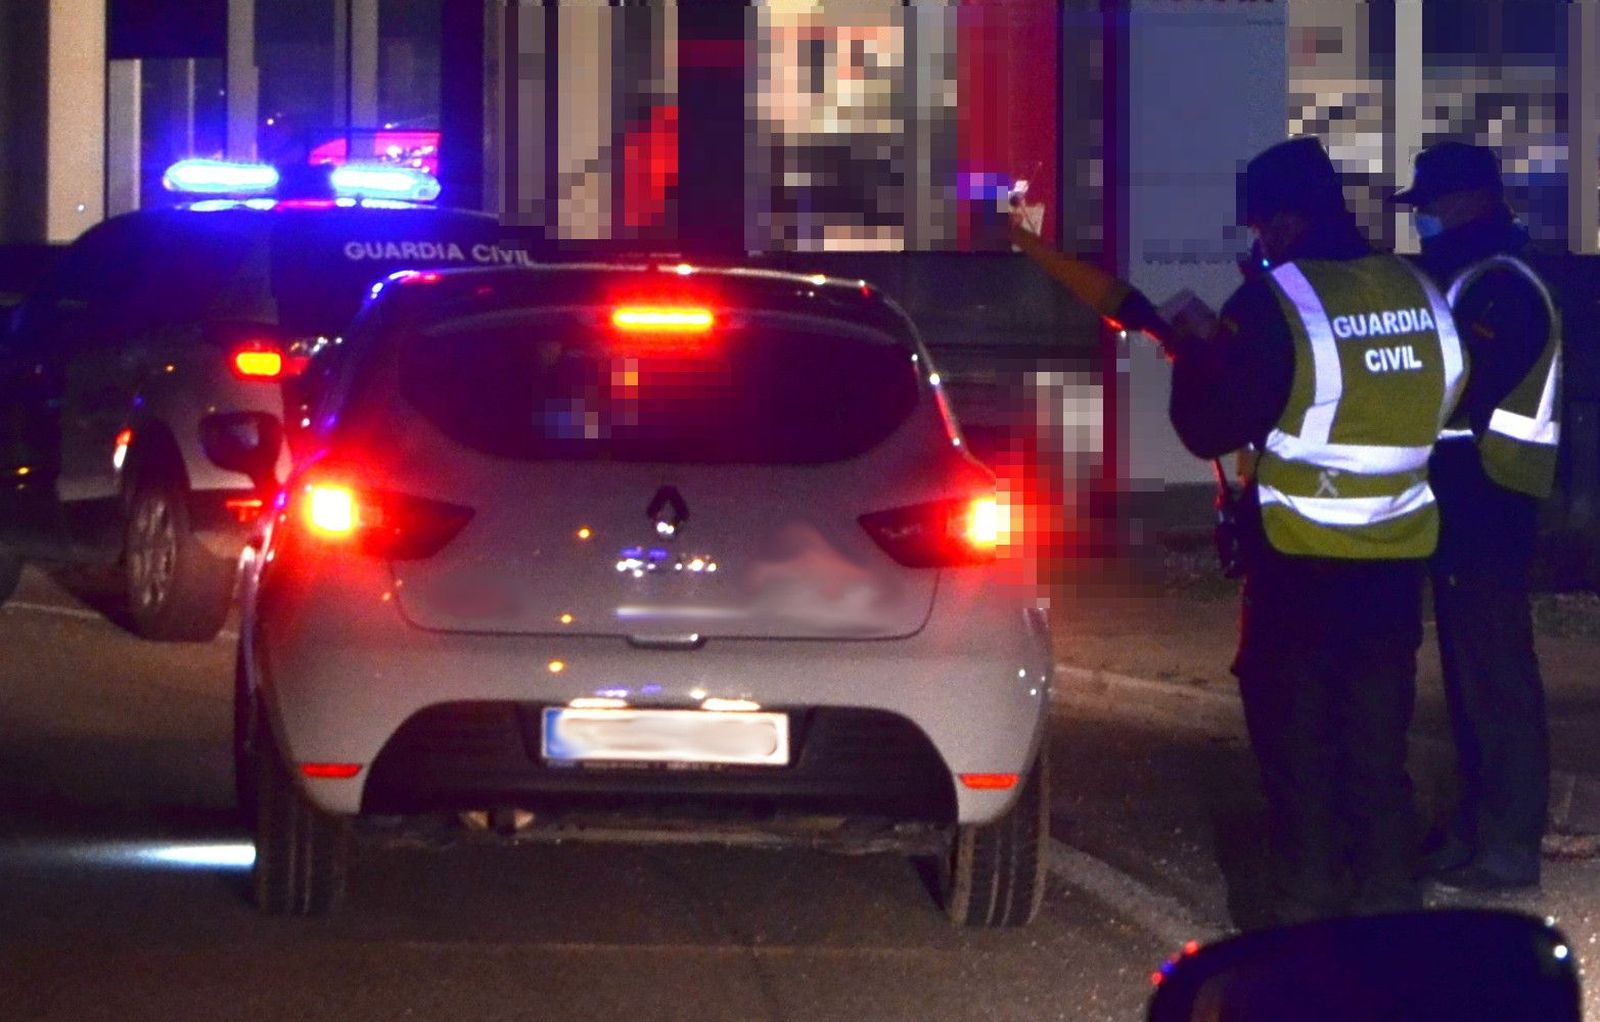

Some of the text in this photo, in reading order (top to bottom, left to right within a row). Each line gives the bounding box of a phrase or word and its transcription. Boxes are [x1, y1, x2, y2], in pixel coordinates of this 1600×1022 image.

[344, 241, 535, 266] GUARDIA CIVIL
[1333, 308, 1435, 338] GUARDIA
[1364, 345, 1423, 372] CIVIL
